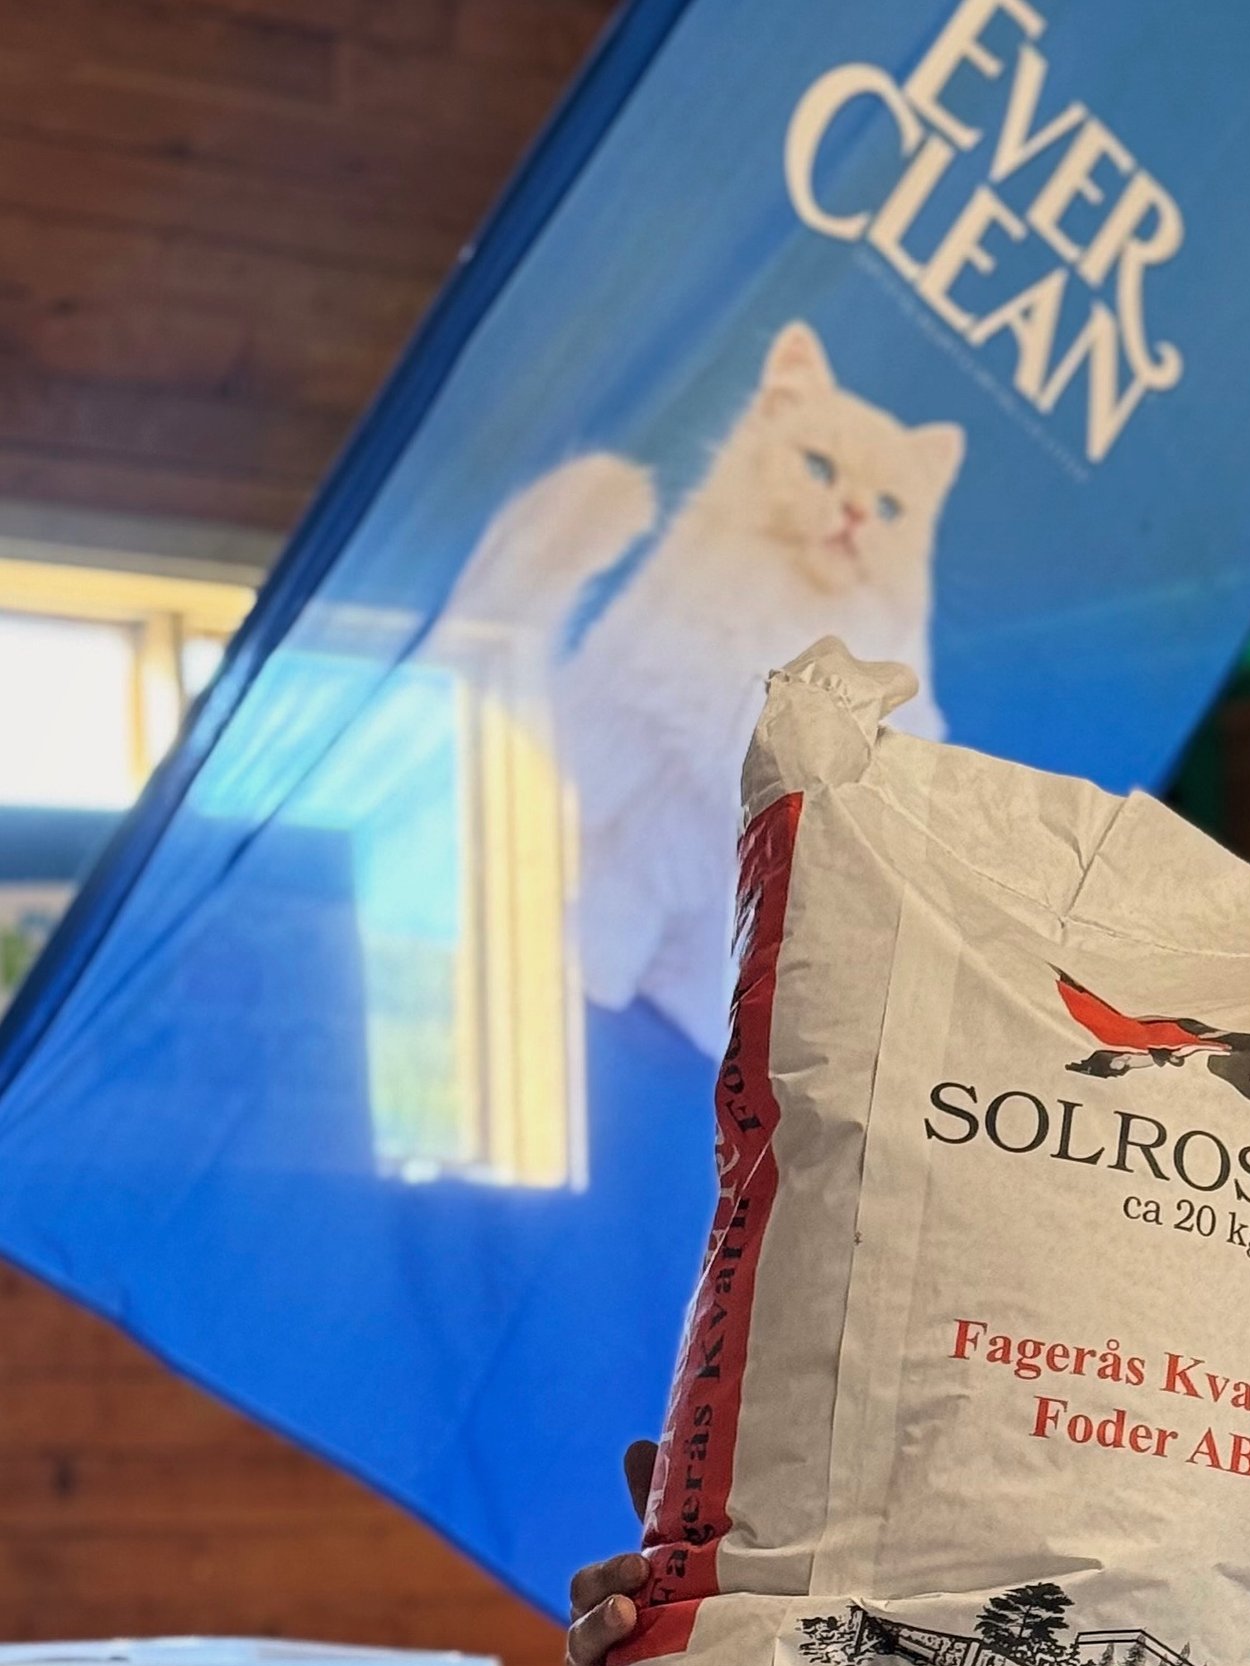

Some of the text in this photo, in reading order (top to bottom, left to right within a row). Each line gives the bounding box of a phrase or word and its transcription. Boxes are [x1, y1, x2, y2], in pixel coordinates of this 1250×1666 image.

[902, 0, 1184, 391] EVER
[785, 62, 1147, 463] CLEAN
[1123, 1194, 1162, 1226] ca
[1173, 1199, 1217, 1237] 20
[948, 1318, 1145, 1386] Fagerås
[1029, 1395, 1179, 1459] Foder
